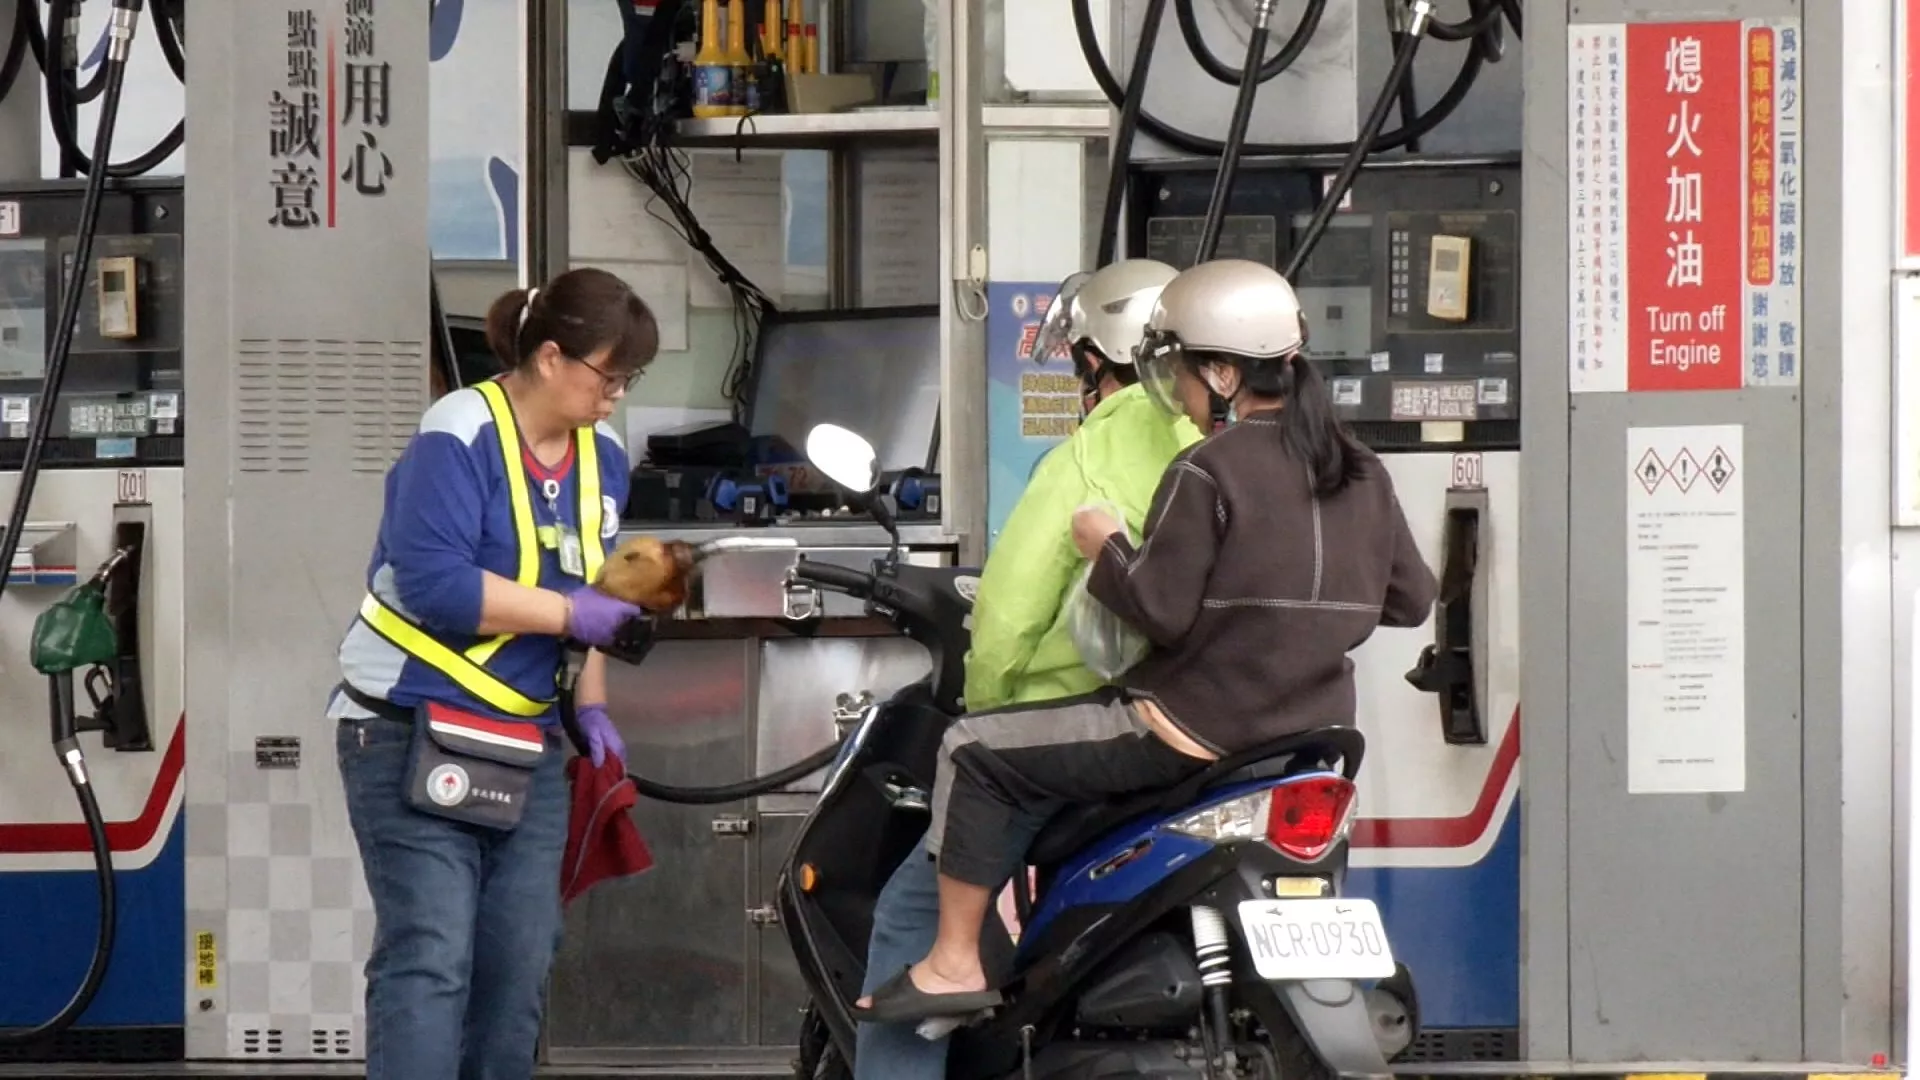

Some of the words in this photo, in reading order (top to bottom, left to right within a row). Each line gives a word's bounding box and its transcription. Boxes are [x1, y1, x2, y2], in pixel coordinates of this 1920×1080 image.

[269, 9, 321, 229] 點點誠意
[1664, 36, 1703, 288] 熄火加油
[1751, 35, 1771, 280] 機車熄火等候加油
[1646, 306, 1691, 333] Turn
[1700, 305, 1726, 332] off
[1752, 292, 1769, 378] 謝謝您
[1651, 339, 1721, 371] Engine
[121, 473, 143, 497] 701
[1456, 457, 1480, 482] 601
[1251, 921, 1383, 959] NCR-0930
